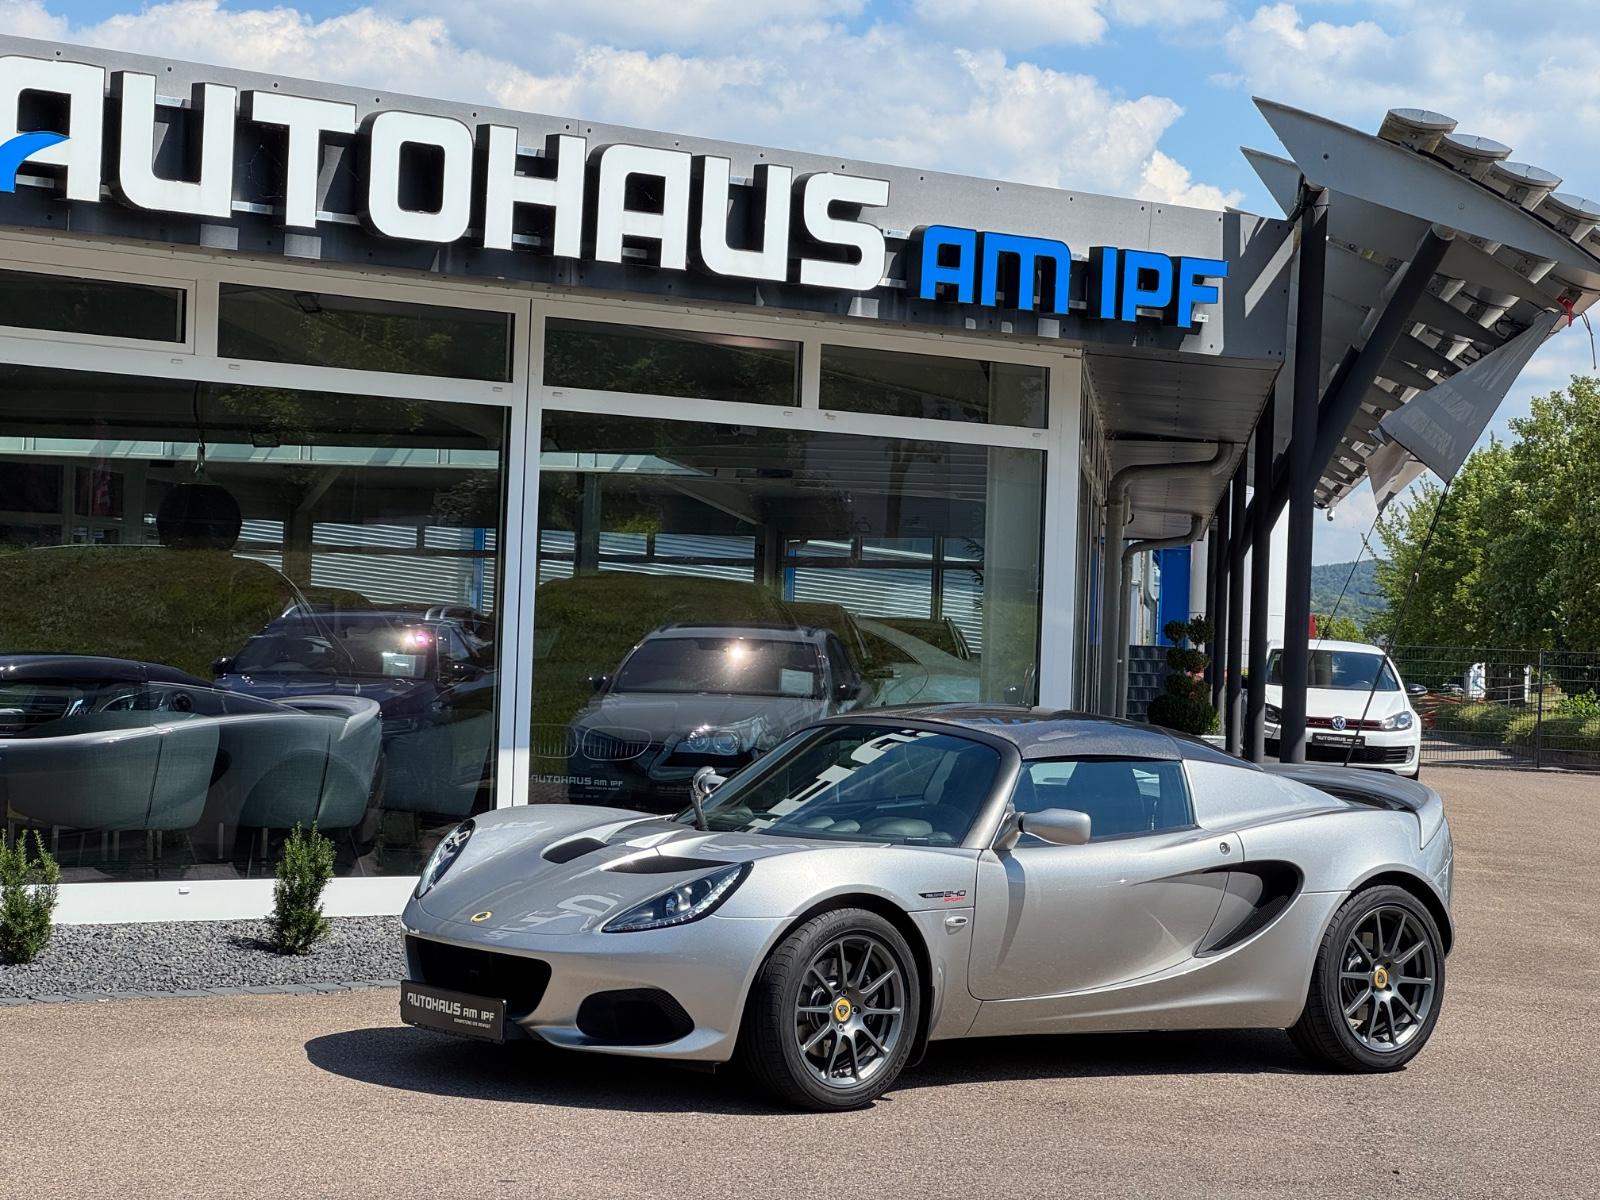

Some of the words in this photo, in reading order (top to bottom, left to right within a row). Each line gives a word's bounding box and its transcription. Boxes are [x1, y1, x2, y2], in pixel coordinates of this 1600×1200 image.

[0, 55, 890, 291] AUTOHAUS
[920, 224, 1072, 315] AM
[1100, 246, 1228, 328] IPF
[530, 774, 592, 785] AUTOHAUS
[407, 992, 461, 1015] AUTOHAUS
[463, 1007, 478, 1019] AM
[480, 1010, 495, 1022] IPF
